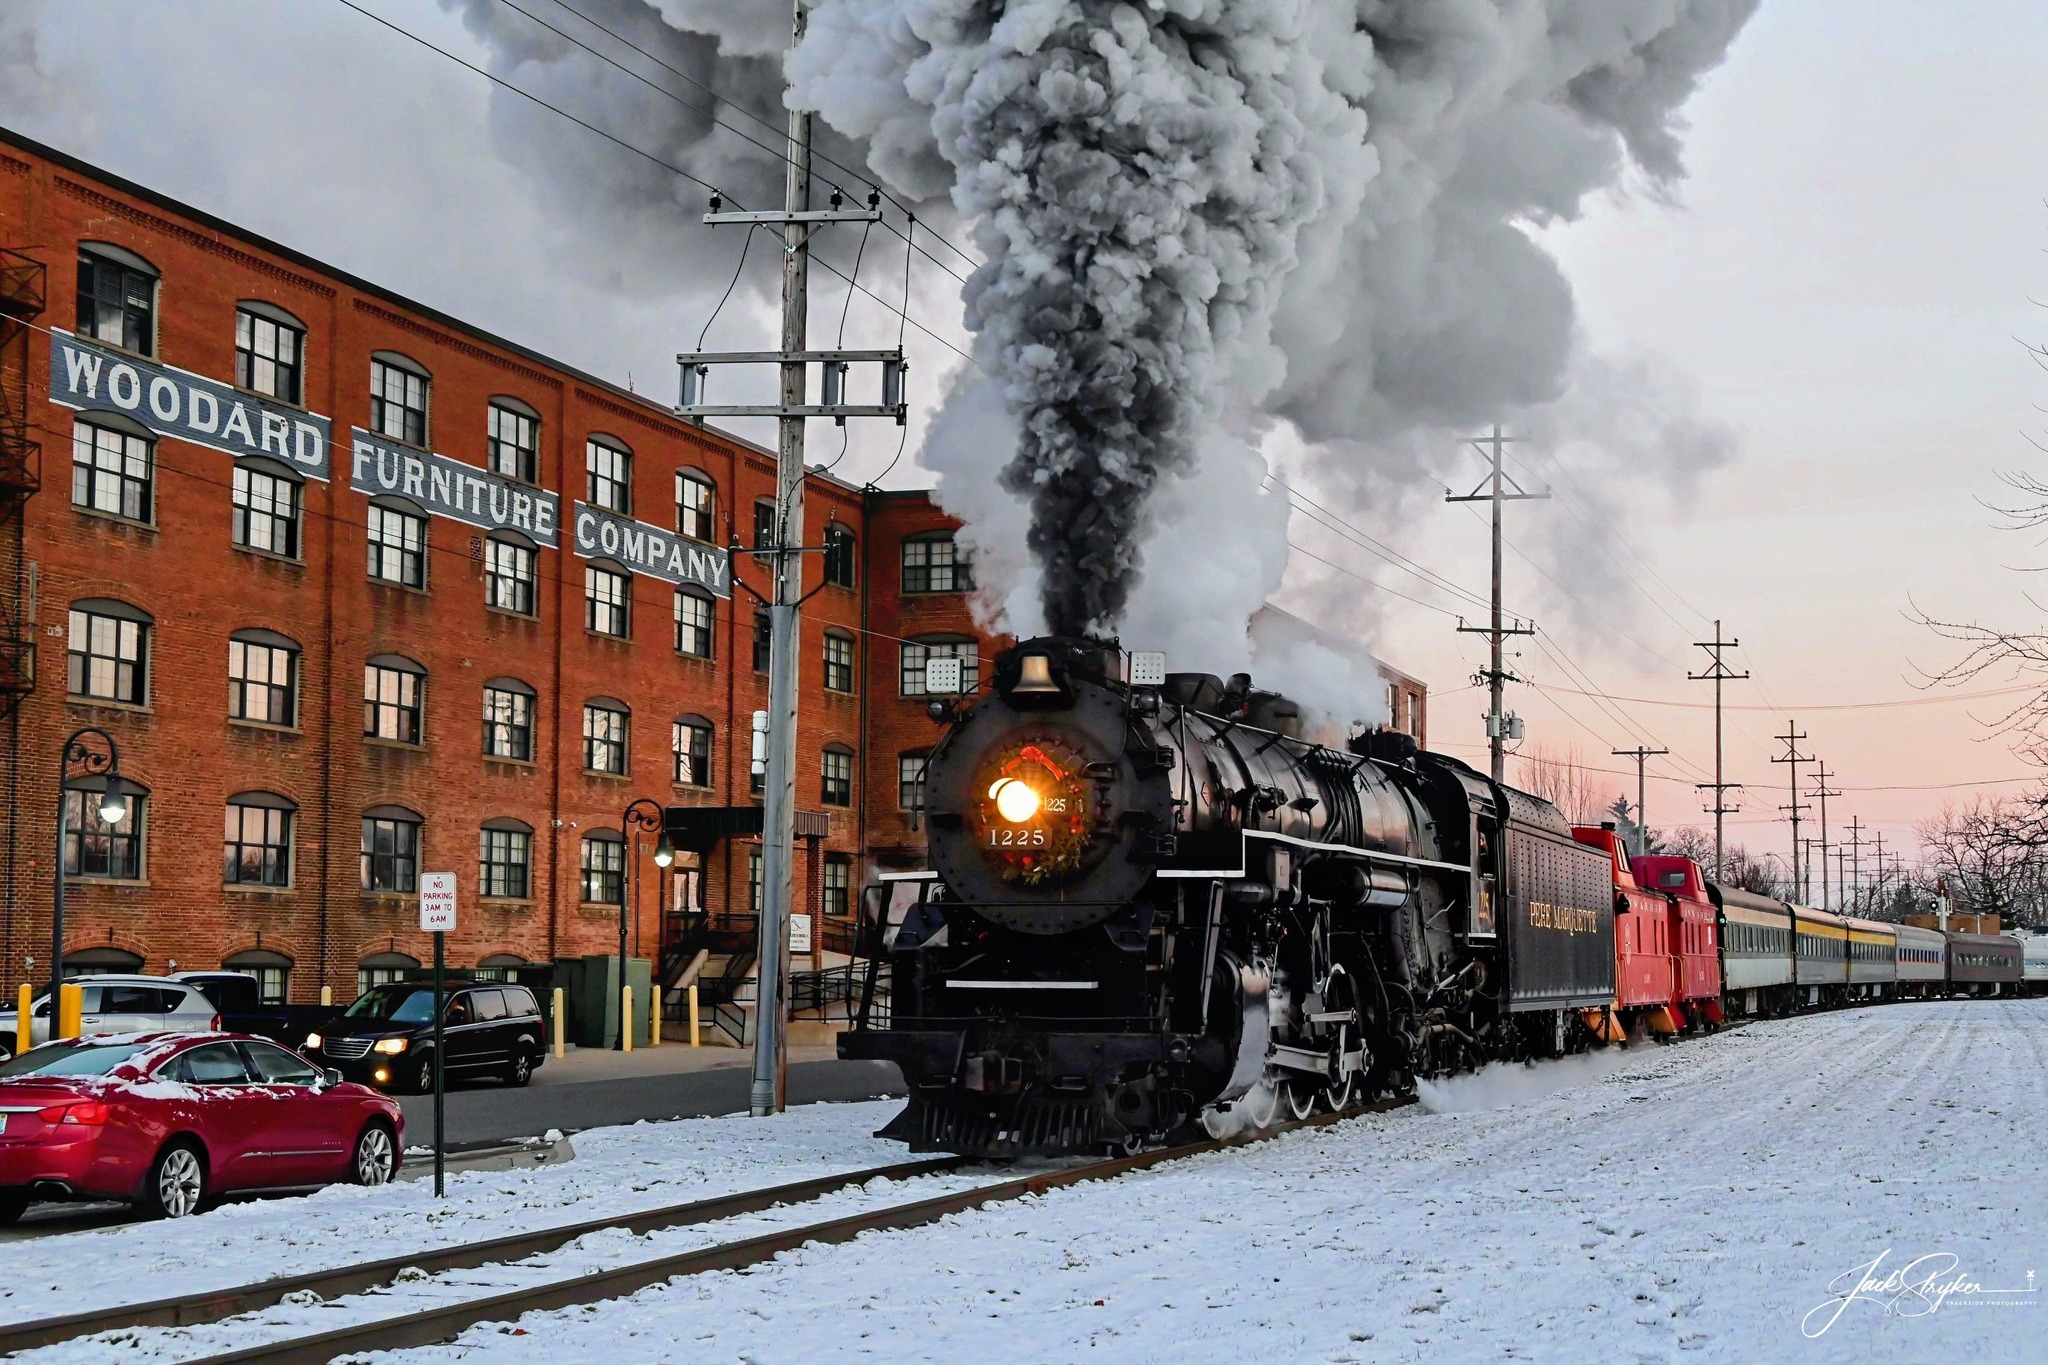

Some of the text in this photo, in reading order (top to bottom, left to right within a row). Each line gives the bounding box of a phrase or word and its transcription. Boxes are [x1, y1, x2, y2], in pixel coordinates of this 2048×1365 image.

[62, 345, 727, 588] WOODARD FURNITURE COMPANY
[1044, 796, 1066, 813] 1225
[990, 828, 1045, 846] 1225
[433, 881, 443, 889] NO
[423, 892, 453, 900] PARKING
[444, 903, 452, 911] TO
[1530, 901, 1597, 937] PERE MARQUETTE
